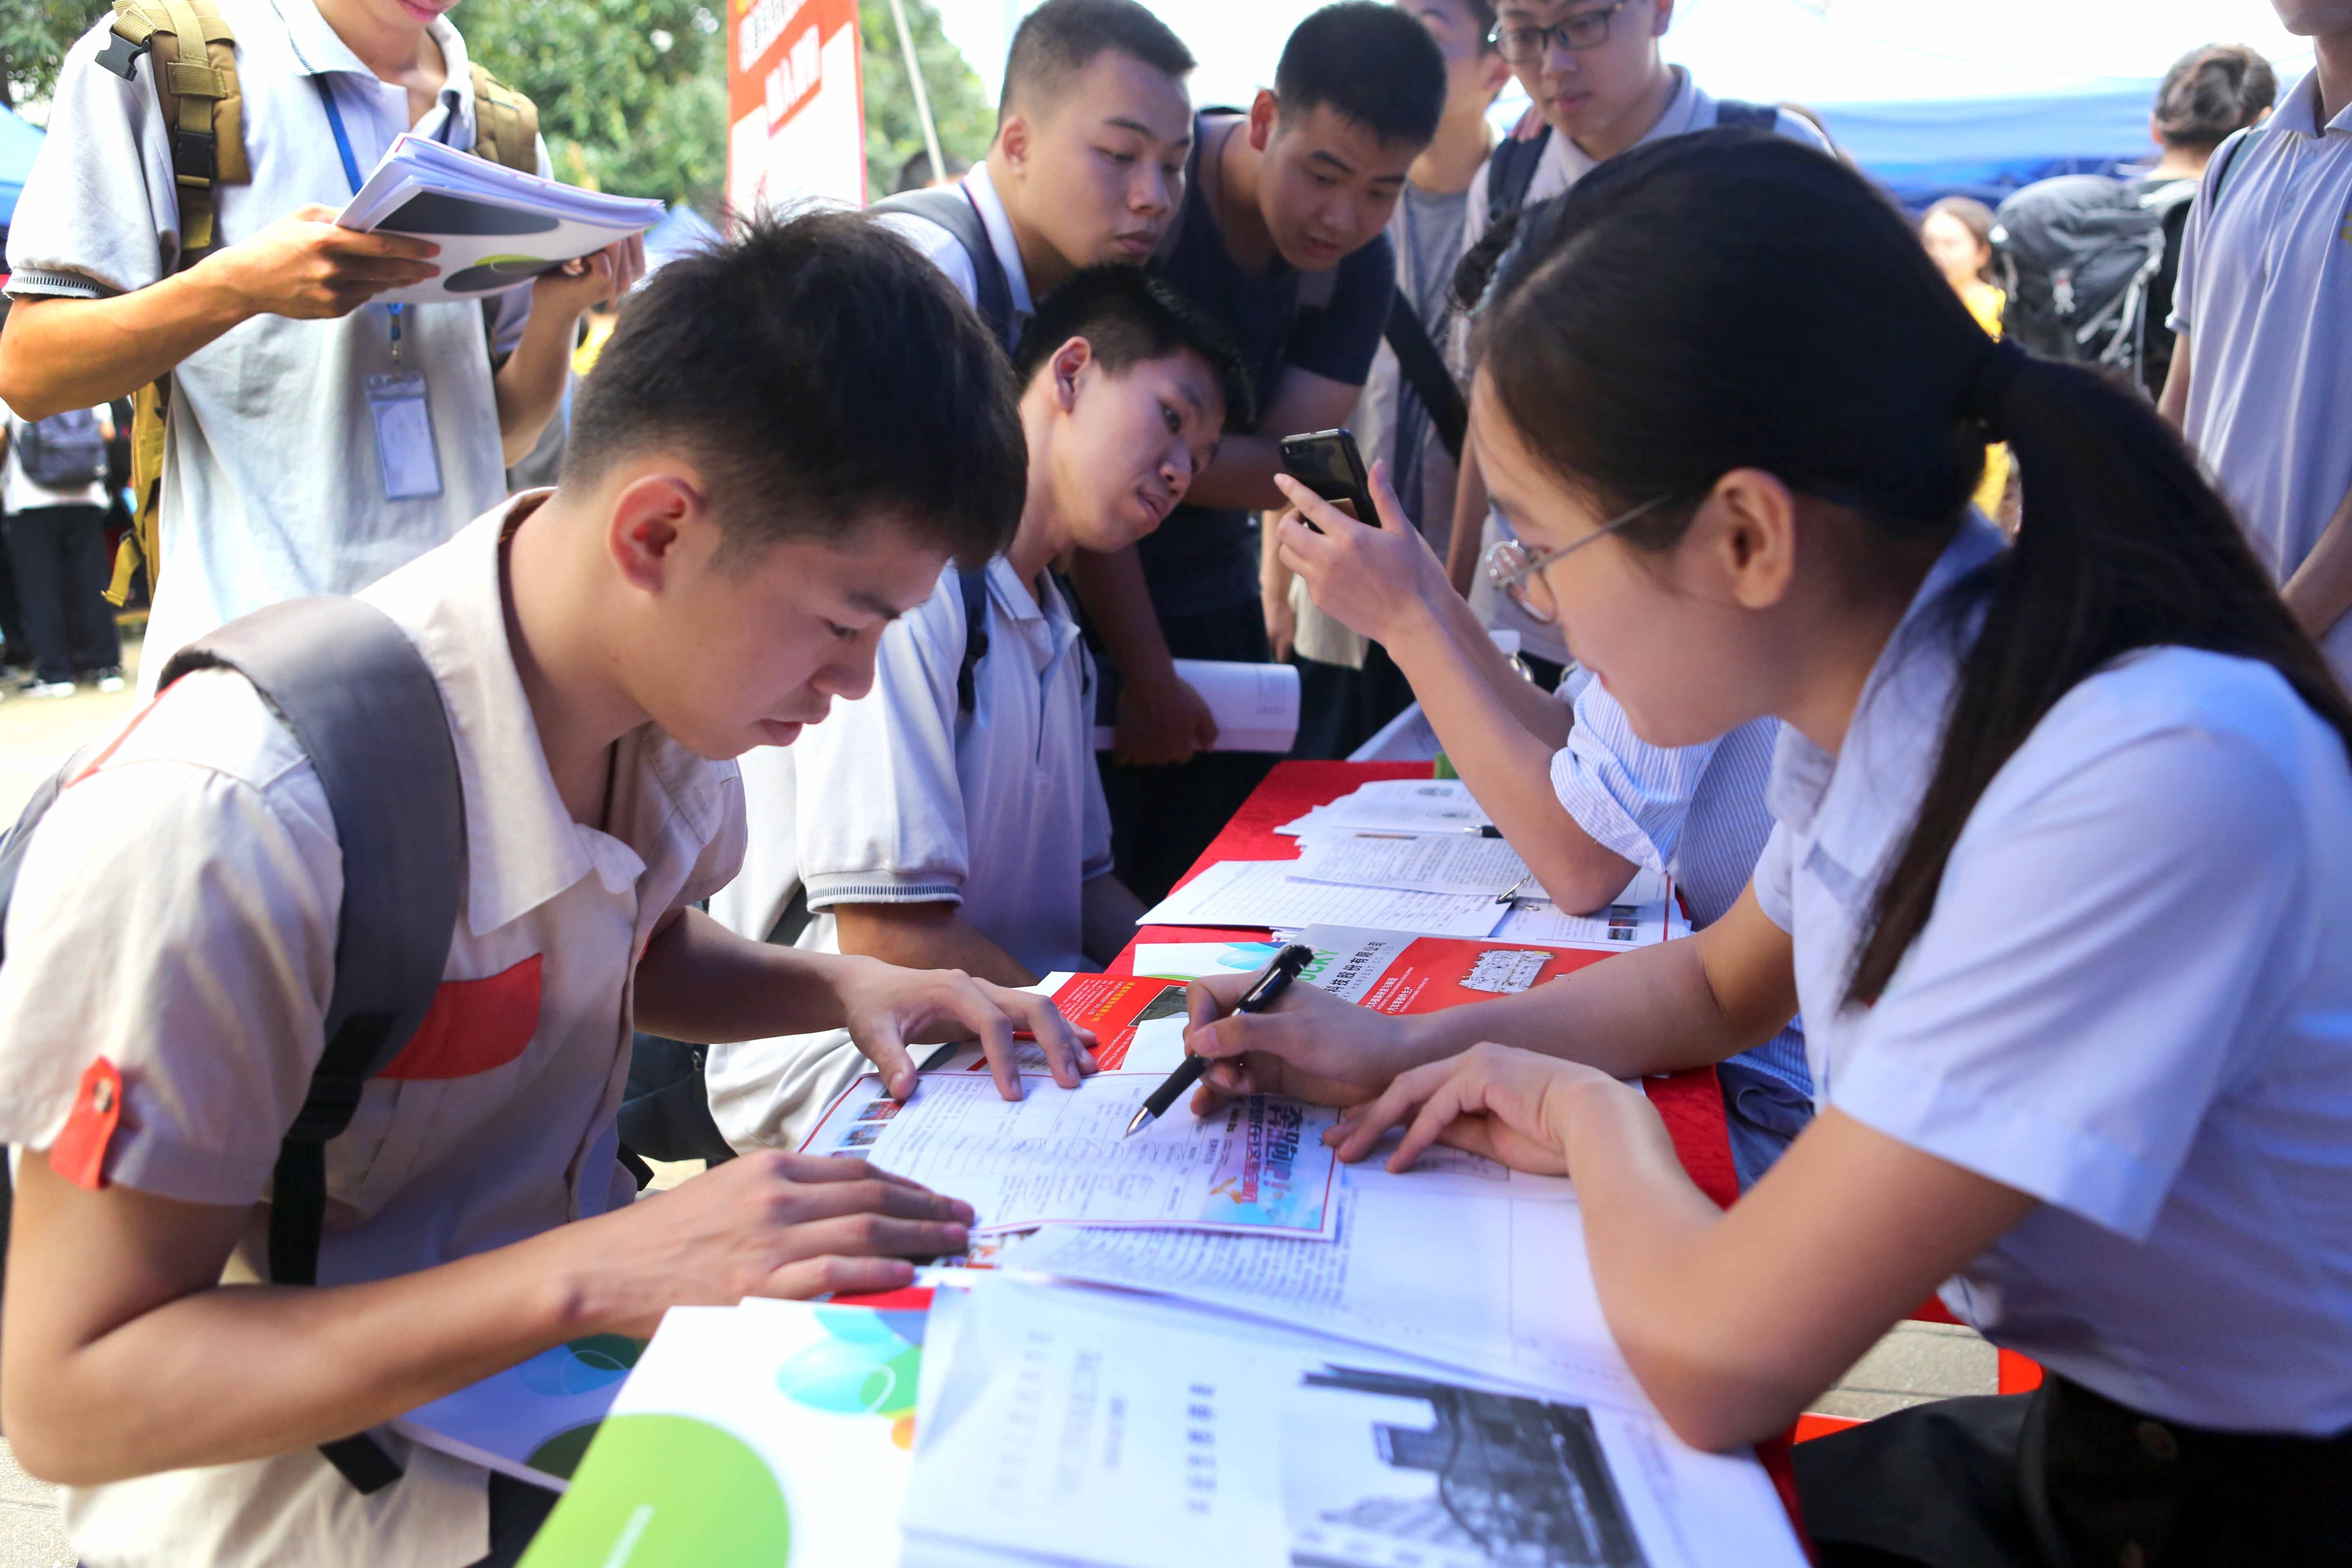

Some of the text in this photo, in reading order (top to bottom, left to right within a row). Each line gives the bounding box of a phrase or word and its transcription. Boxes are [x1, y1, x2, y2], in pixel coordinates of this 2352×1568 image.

[1298, 949, 1339, 982] UCKY
[1325, 942, 1386, 993] 科技股份有限公司
